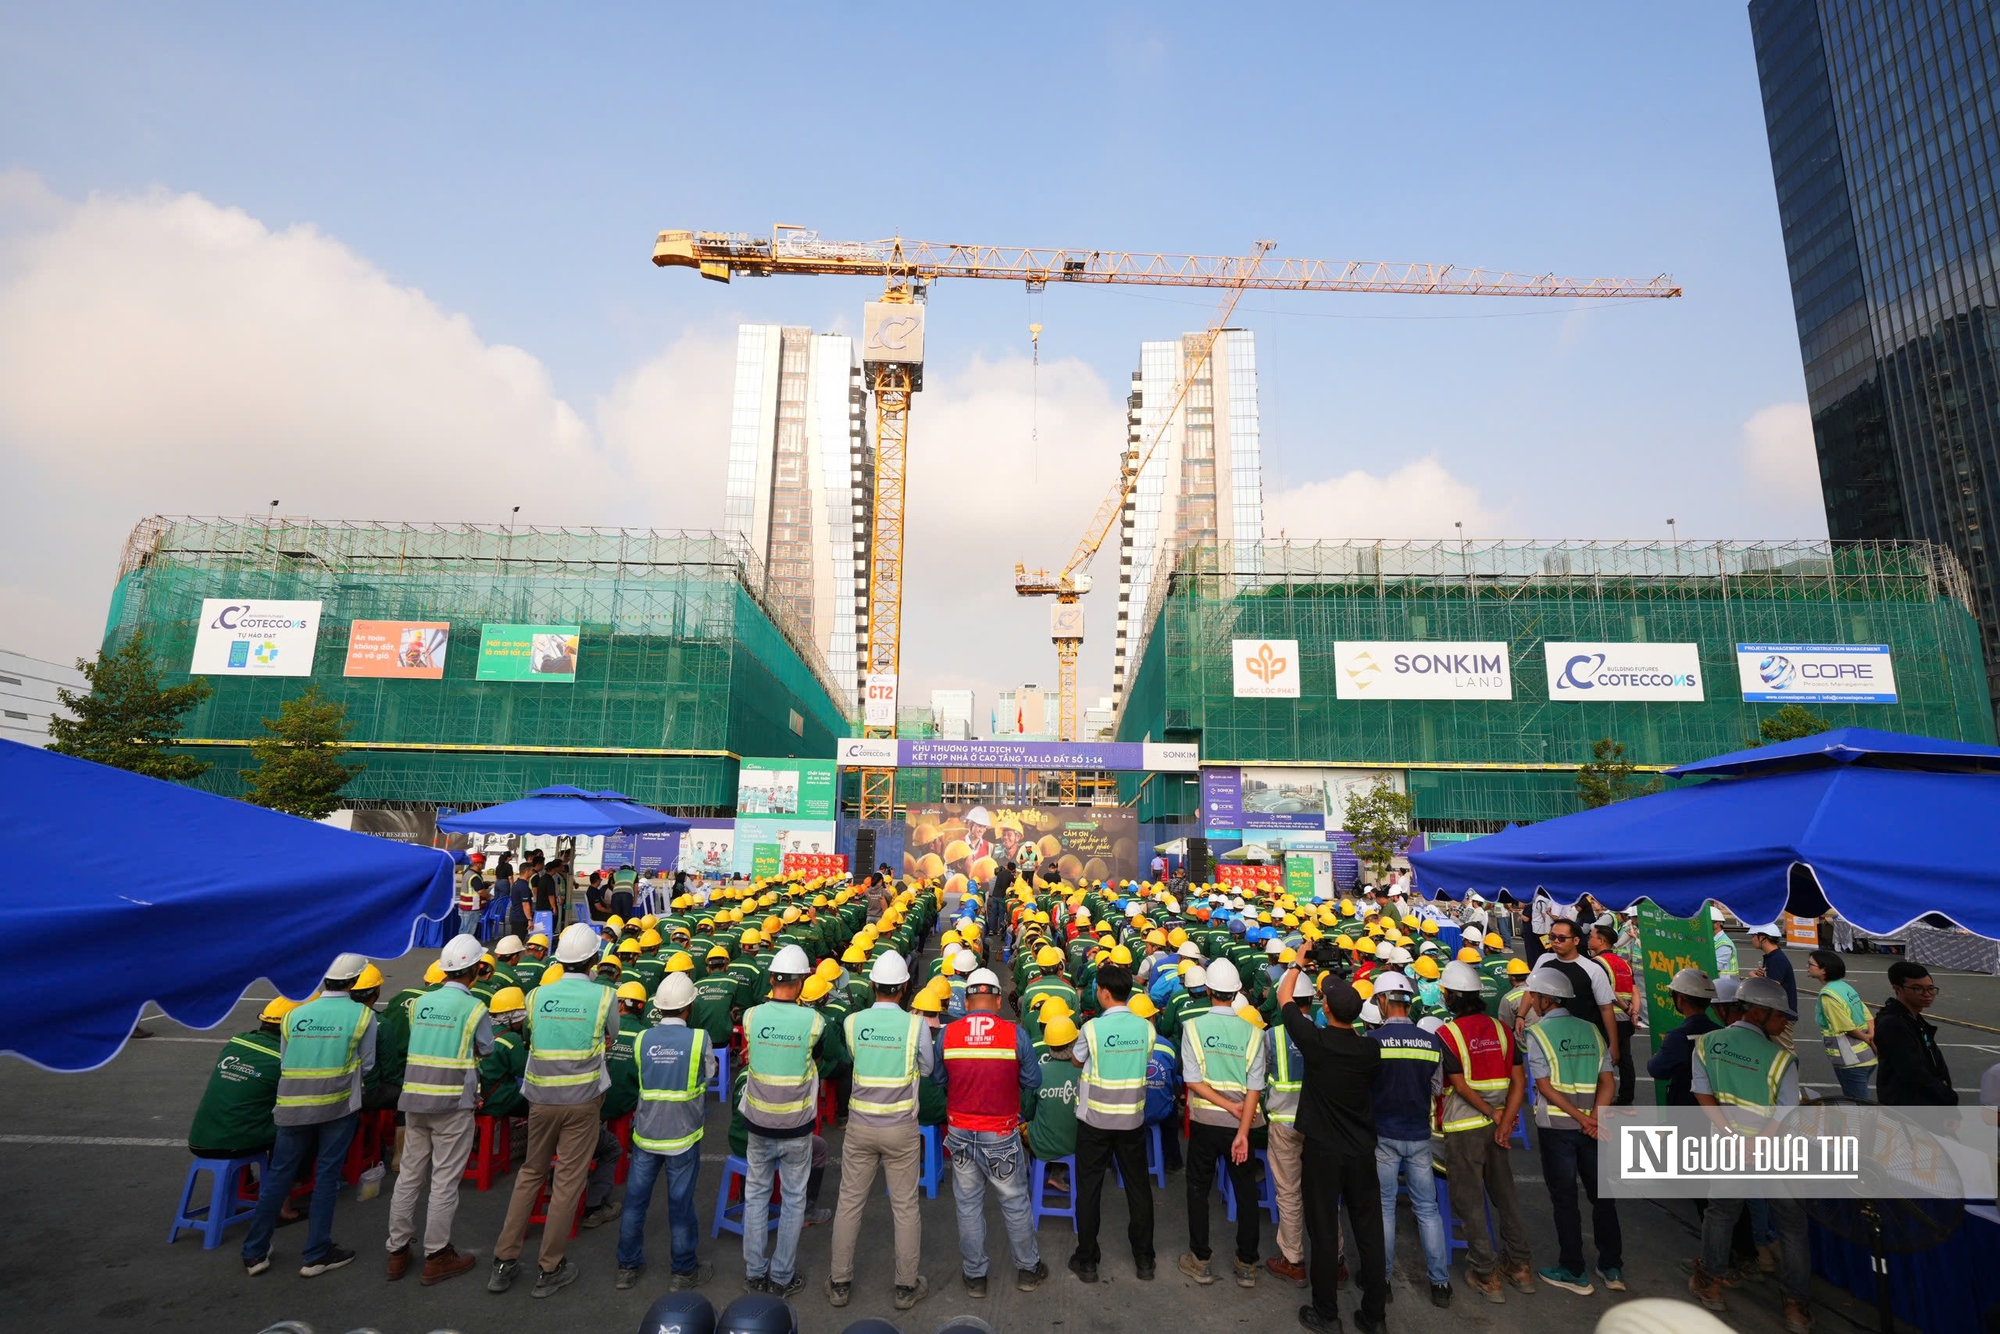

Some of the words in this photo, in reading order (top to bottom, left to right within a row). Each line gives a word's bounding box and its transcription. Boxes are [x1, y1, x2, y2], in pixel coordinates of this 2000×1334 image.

[1394, 654, 1501, 674] SONKIM
[1801, 664, 1873, 679] CORE
[1455, 676, 1504, 688] LAND
[868, 685, 893, 700] CT2
[933, 744, 969, 752] THƯƠNG
[970, 746, 987, 754] MẠI
[989, 746, 1011, 754] DỊCH
[1013, 746, 1025, 755] VỤ
[1163, 751, 1196, 759] SONKIM
[912, 752, 929, 761] KẾT
[930, 753, 949, 762] HỢP
[950, 752, 968, 761] NHÀ
[1023, 755, 1038, 763] TẠI
[1040, 754, 1051, 763] LÔ
[1053, 753, 1070, 763] ĐẤT
[1072, 754, 1083, 763] SỐ
[1381, 1037, 1401, 1047] VIÊN
[1402, 1038, 1432, 1049] PHƯƠNG
